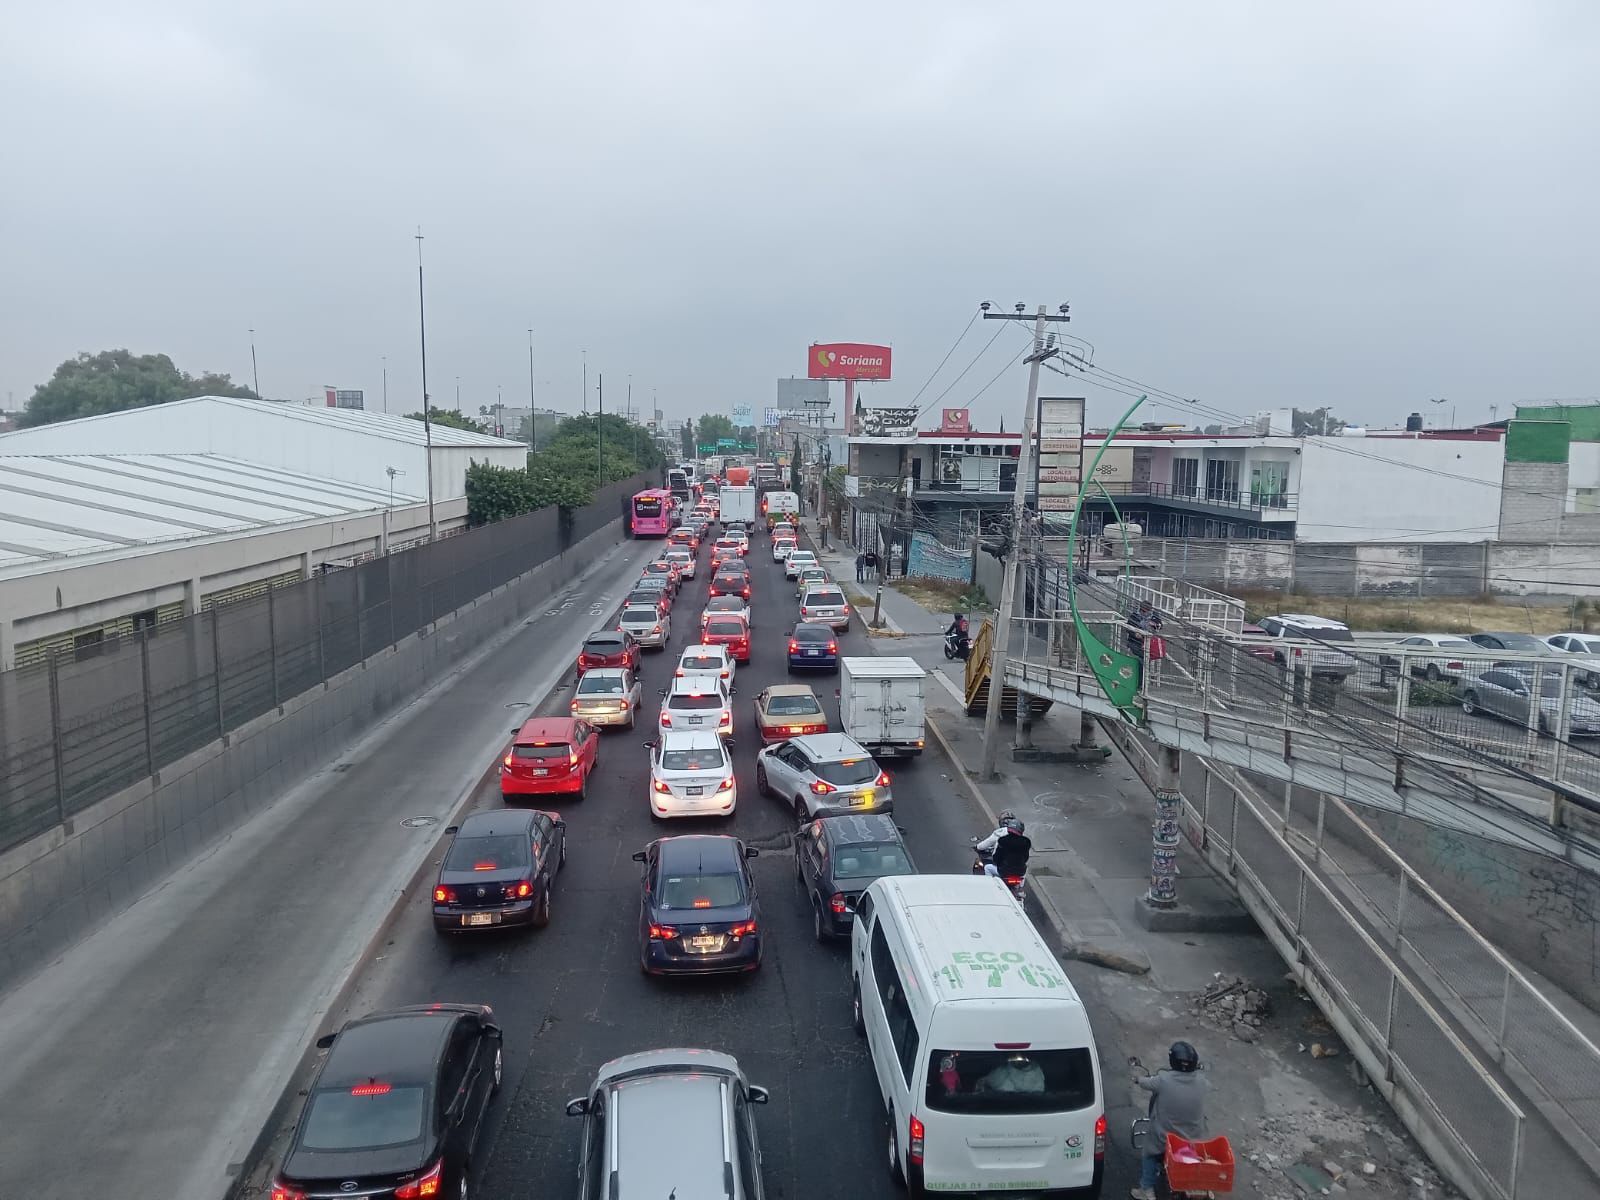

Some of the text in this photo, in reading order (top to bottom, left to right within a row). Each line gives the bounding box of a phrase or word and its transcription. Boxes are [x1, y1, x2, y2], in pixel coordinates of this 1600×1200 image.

[840, 355, 883, 366] Soriana
[952, 951, 1025, 963] ECO
[926, 1182, 967, 1190] QUEJAS
[970, 1182, 981, 1190] 01
